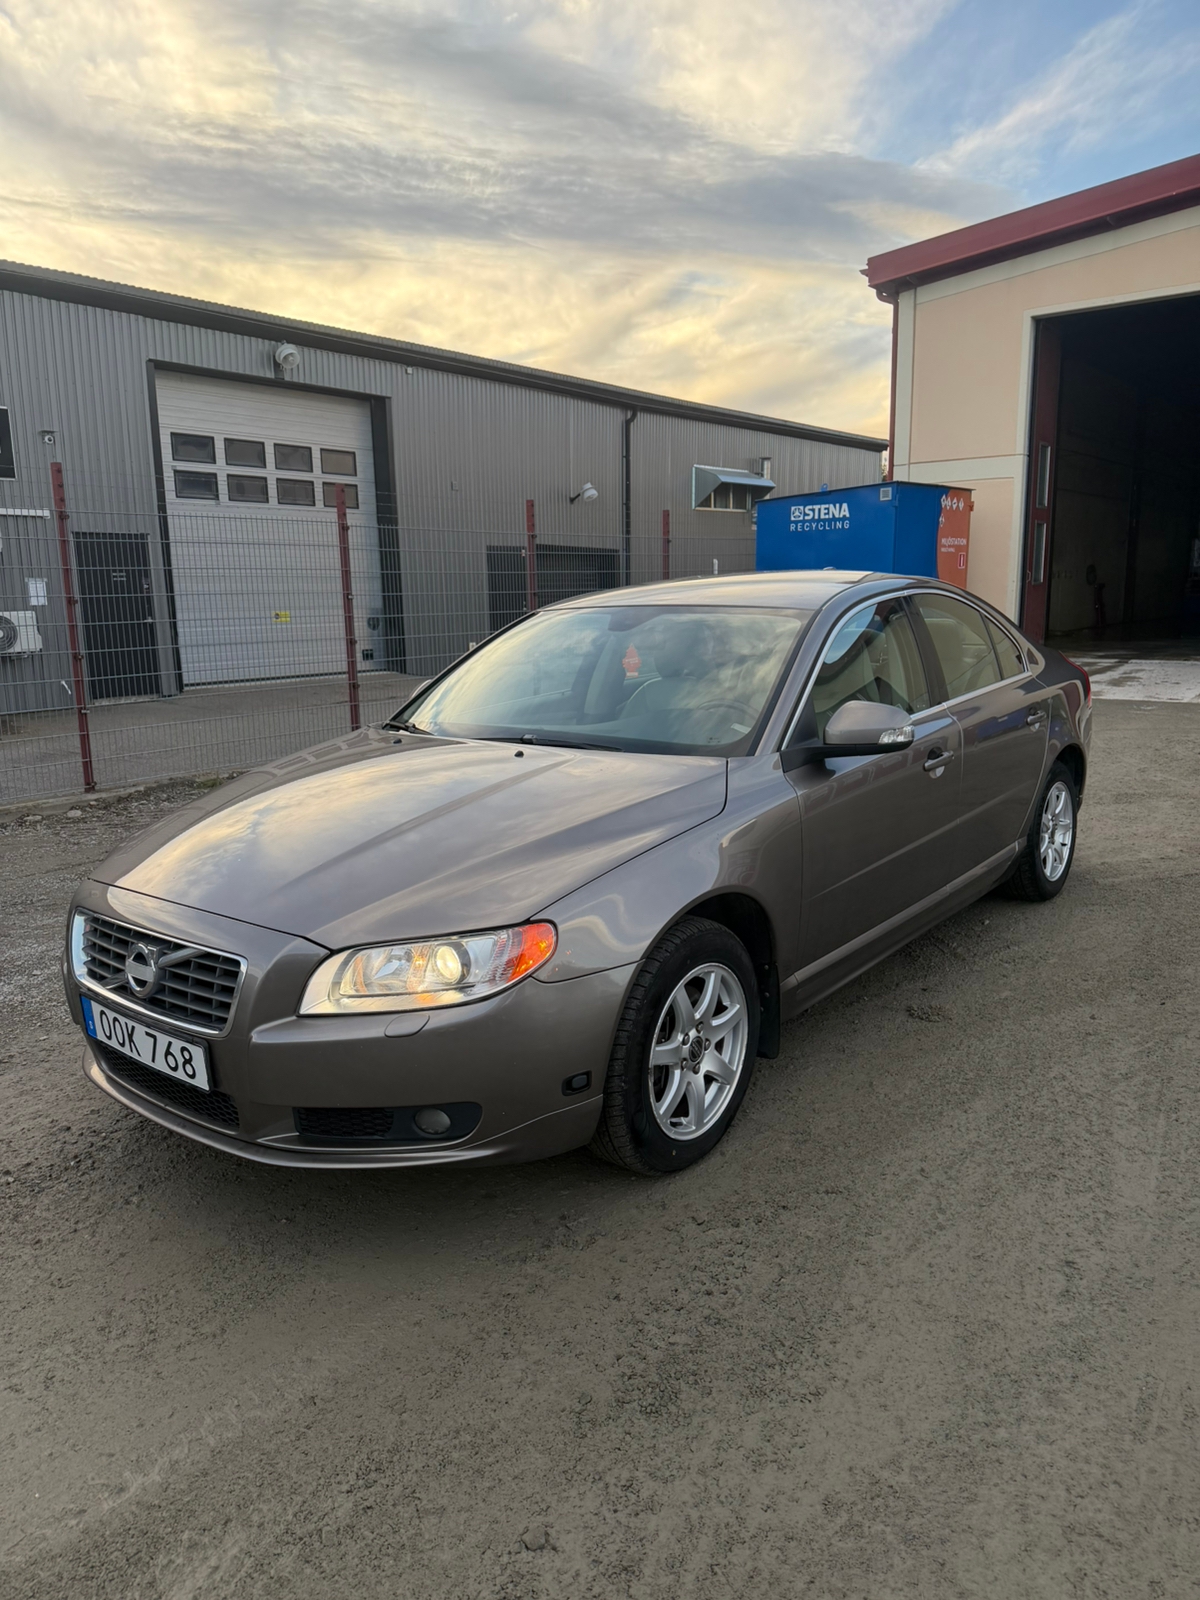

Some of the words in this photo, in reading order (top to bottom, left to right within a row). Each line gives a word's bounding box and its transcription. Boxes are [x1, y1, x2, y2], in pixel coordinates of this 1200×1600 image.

[804, 503, 850, 520] STENA
[790, 520, 850, 532] RECYCLING
[100, 1009, 142, 1058] OOK
[145, 1030, 197, 1080] 768
